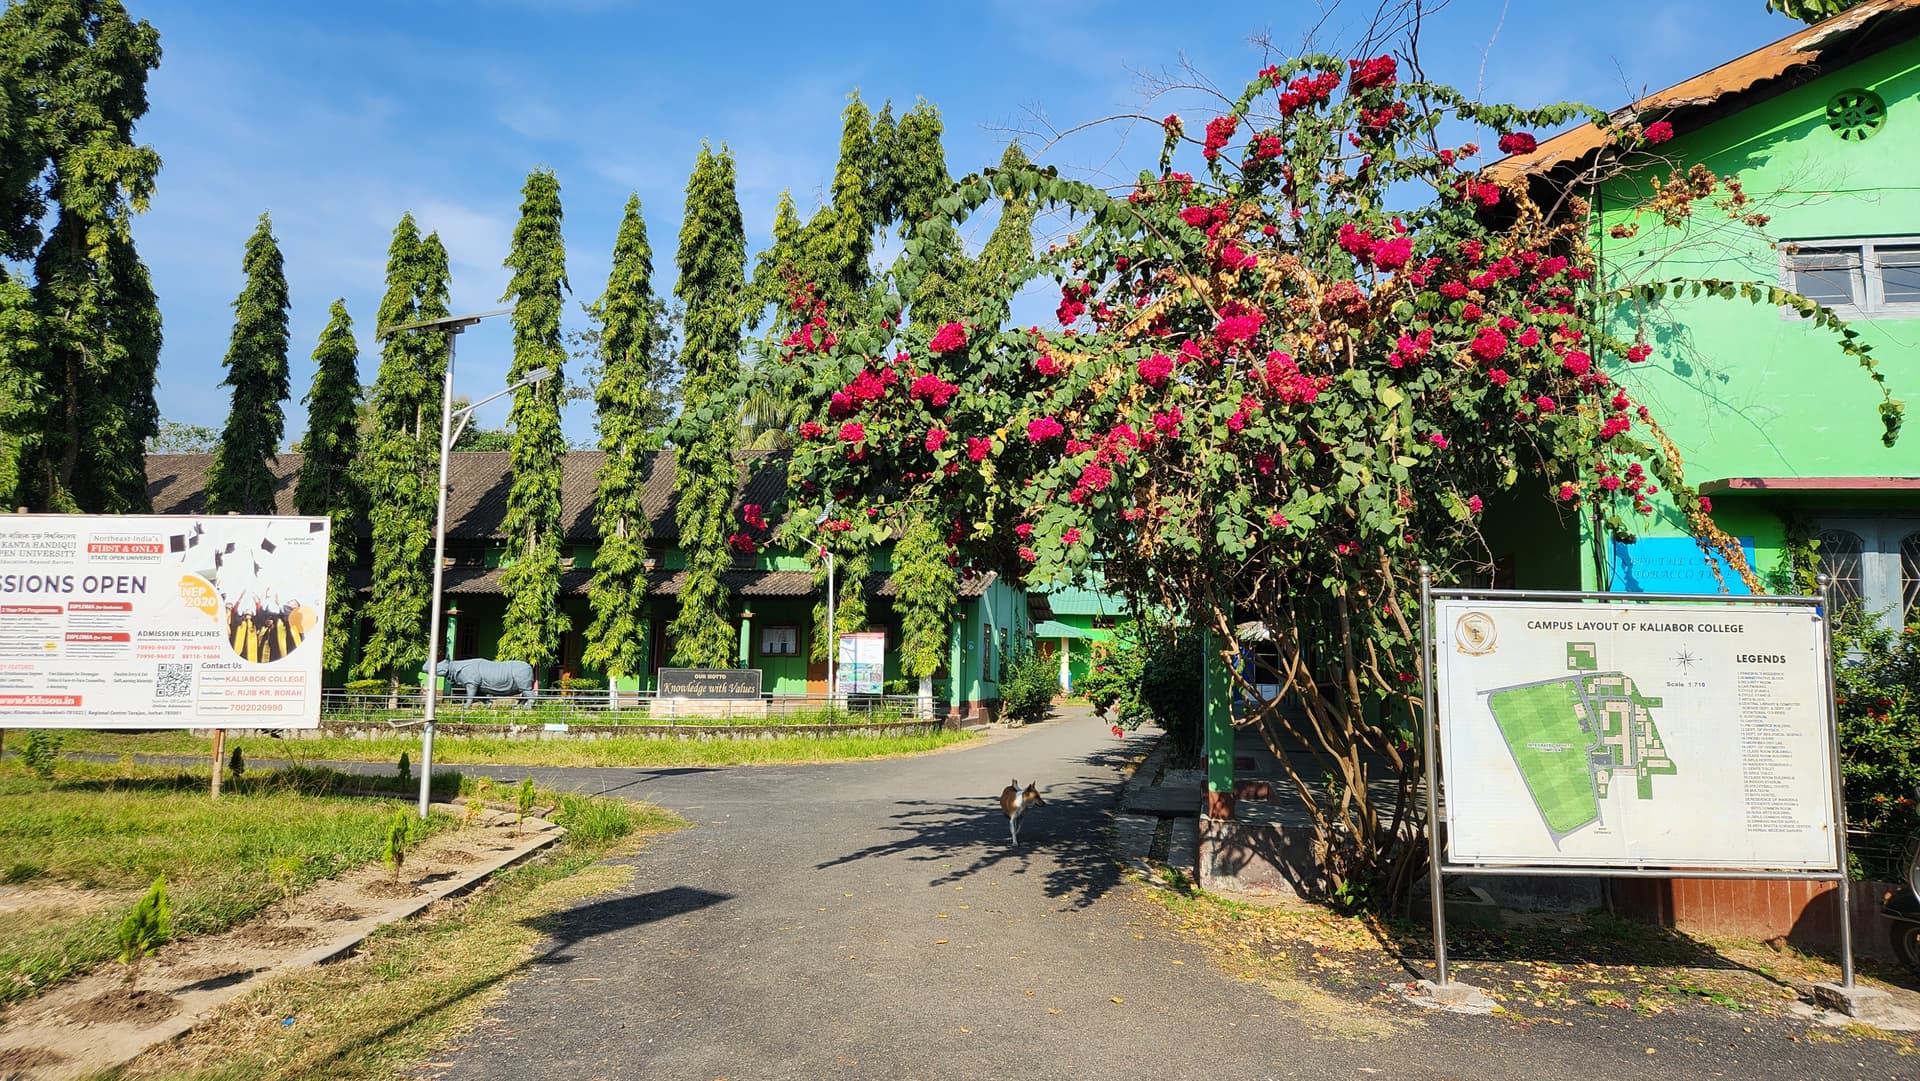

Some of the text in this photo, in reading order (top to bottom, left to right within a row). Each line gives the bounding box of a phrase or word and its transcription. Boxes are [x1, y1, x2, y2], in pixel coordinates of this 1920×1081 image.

[32, 541, 77, 550] HANDIQUI
[19, 550, 76, 558] UNIVERSITY
[82, 575, 147, 594] OPEN
[182, 587, 206, 597] NEP
[186, 597, 216, 607] 2020
[1527, 621, 1744, 633] CAMPUS LAYOUT OF KALIABOR COLLEGE
[1736, 654, 1786, 664] LEGENDS
[663, 681, 755, 696] Knowledge with Values
